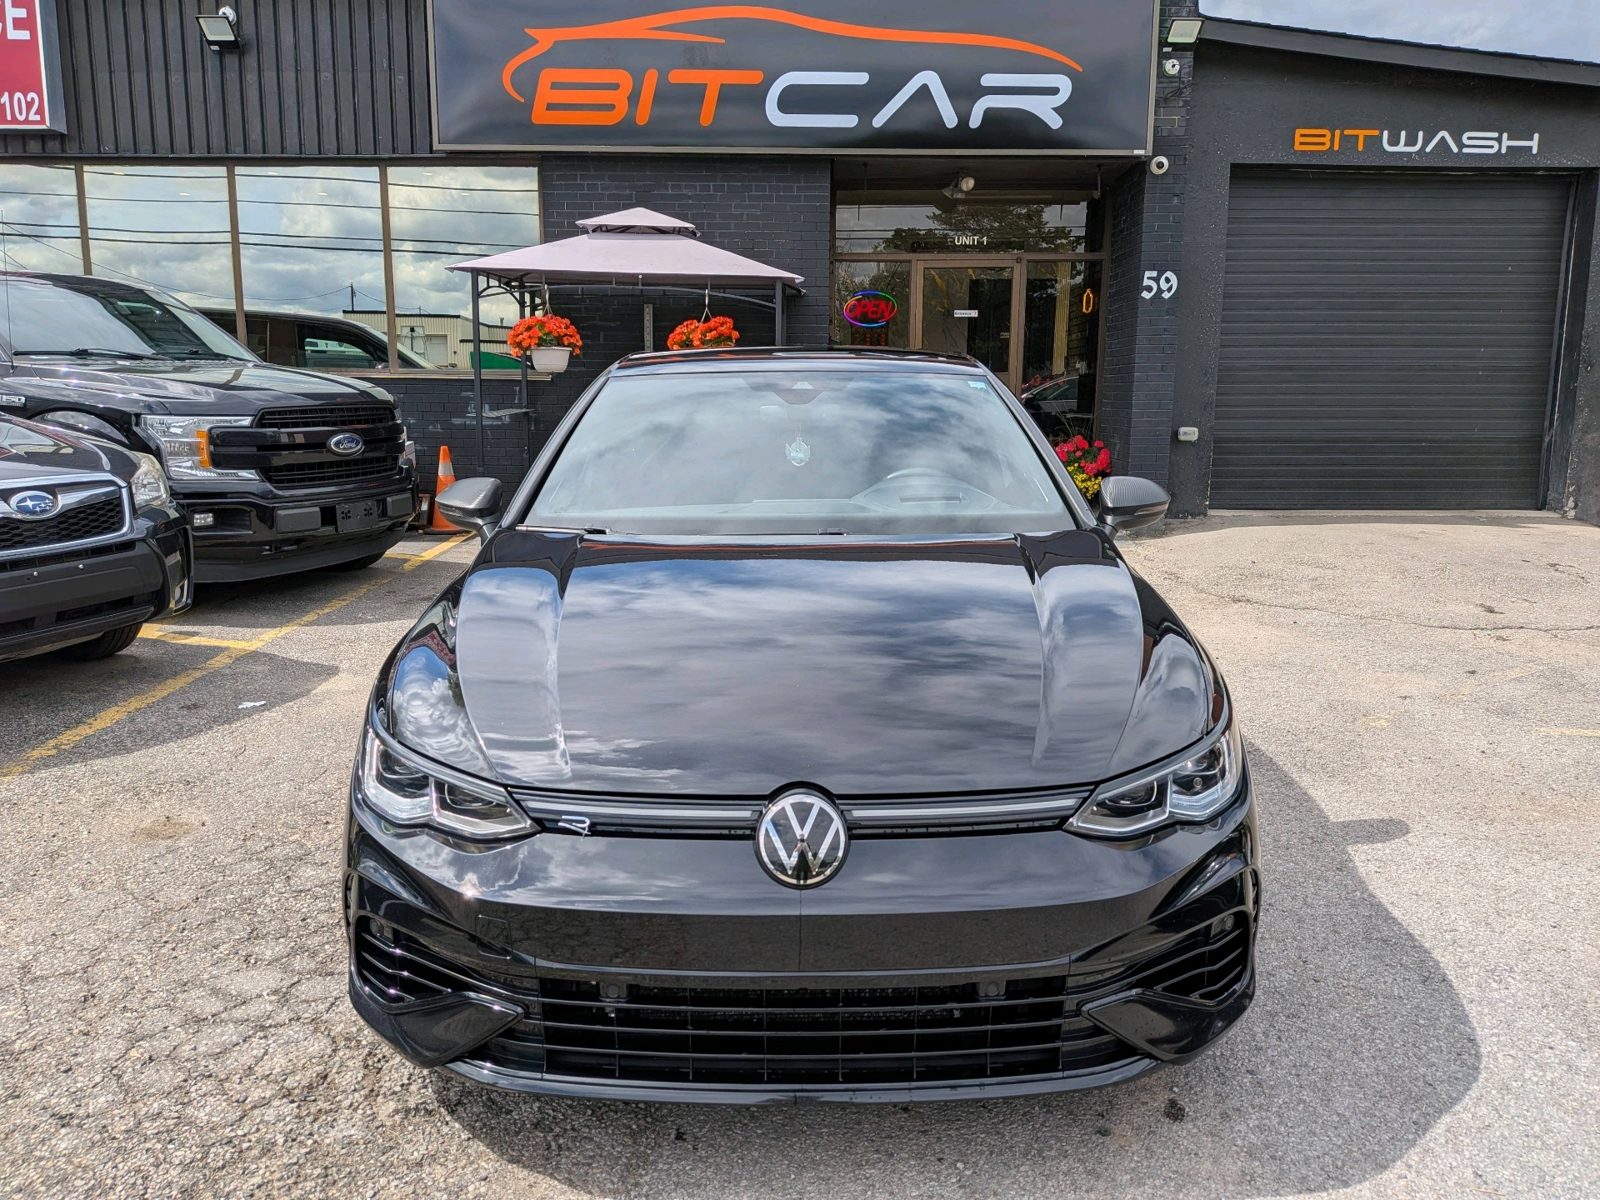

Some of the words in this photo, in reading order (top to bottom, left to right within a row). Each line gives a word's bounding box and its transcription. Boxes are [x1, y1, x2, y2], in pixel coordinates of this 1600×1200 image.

[531, 68, 1073, 130] BITCAR
[1294, 128, 1539, 154] BITWASH
[954, 235, 979, 246] UNIT
[982, 236, 988, 246] 1
[1140, 270, 1178, 300] 59
[847, 300, 893, 319] OPEN
